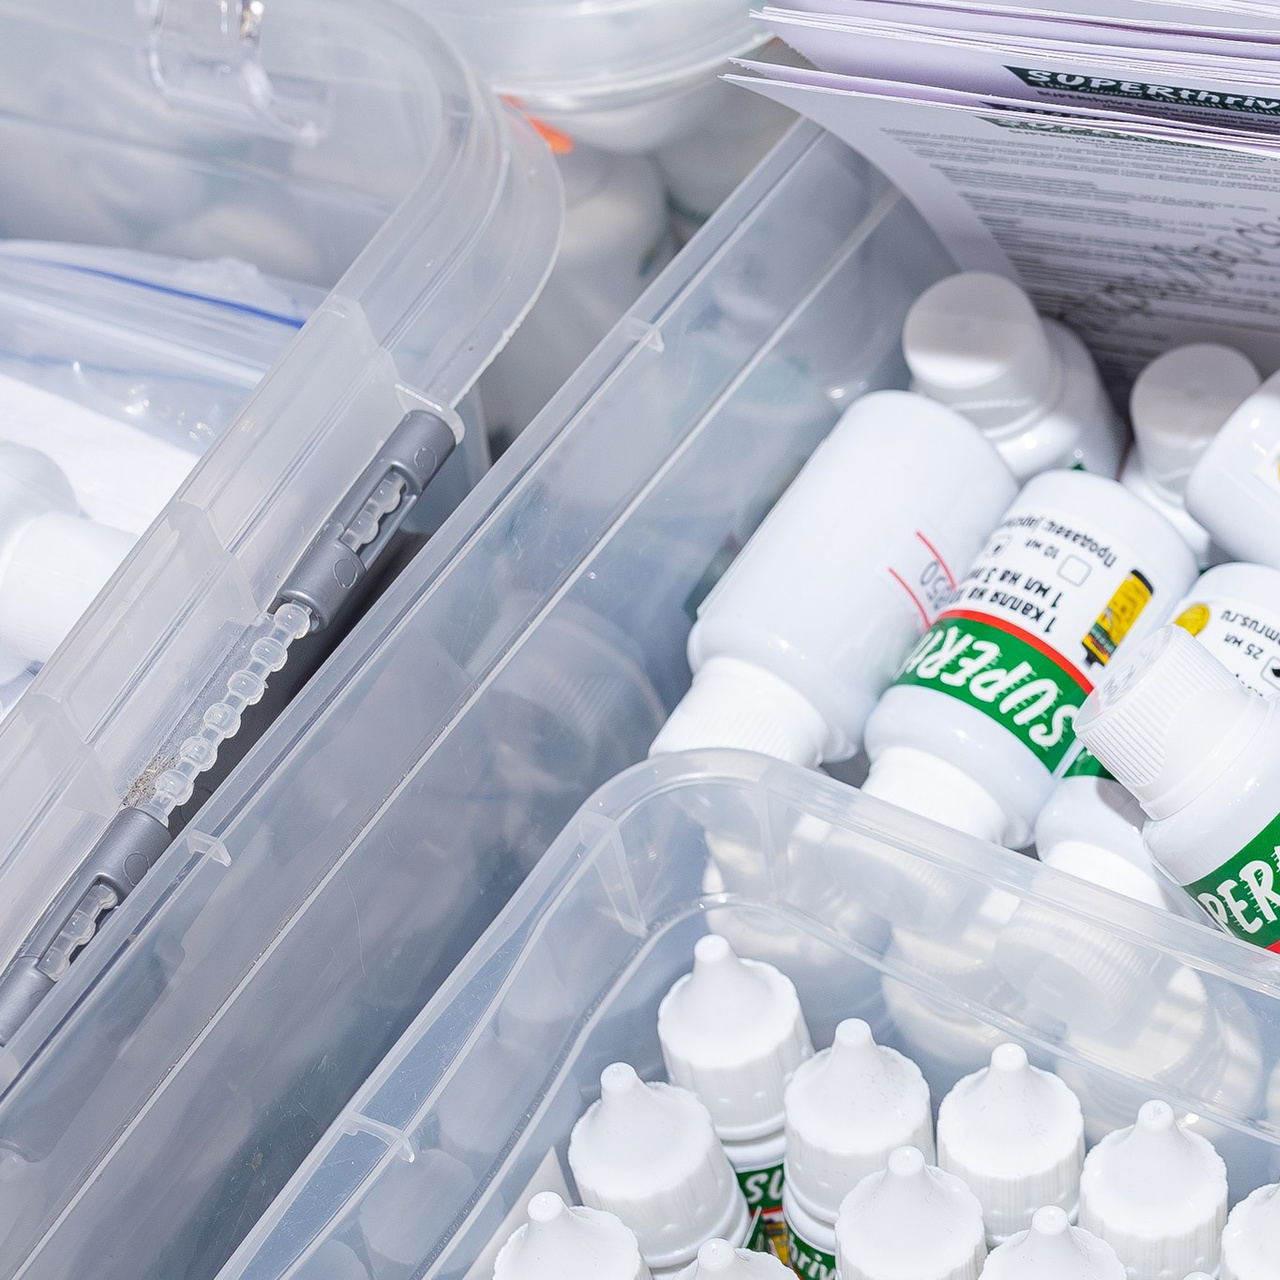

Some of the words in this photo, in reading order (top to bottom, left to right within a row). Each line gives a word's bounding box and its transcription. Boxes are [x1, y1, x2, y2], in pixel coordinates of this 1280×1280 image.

[1023, 578, 1051, 598] мл
[989, 590, 1046, 623] капля
[1224, 634, 1244, 647] мл
[1244, 643, 1264, 660] 25
